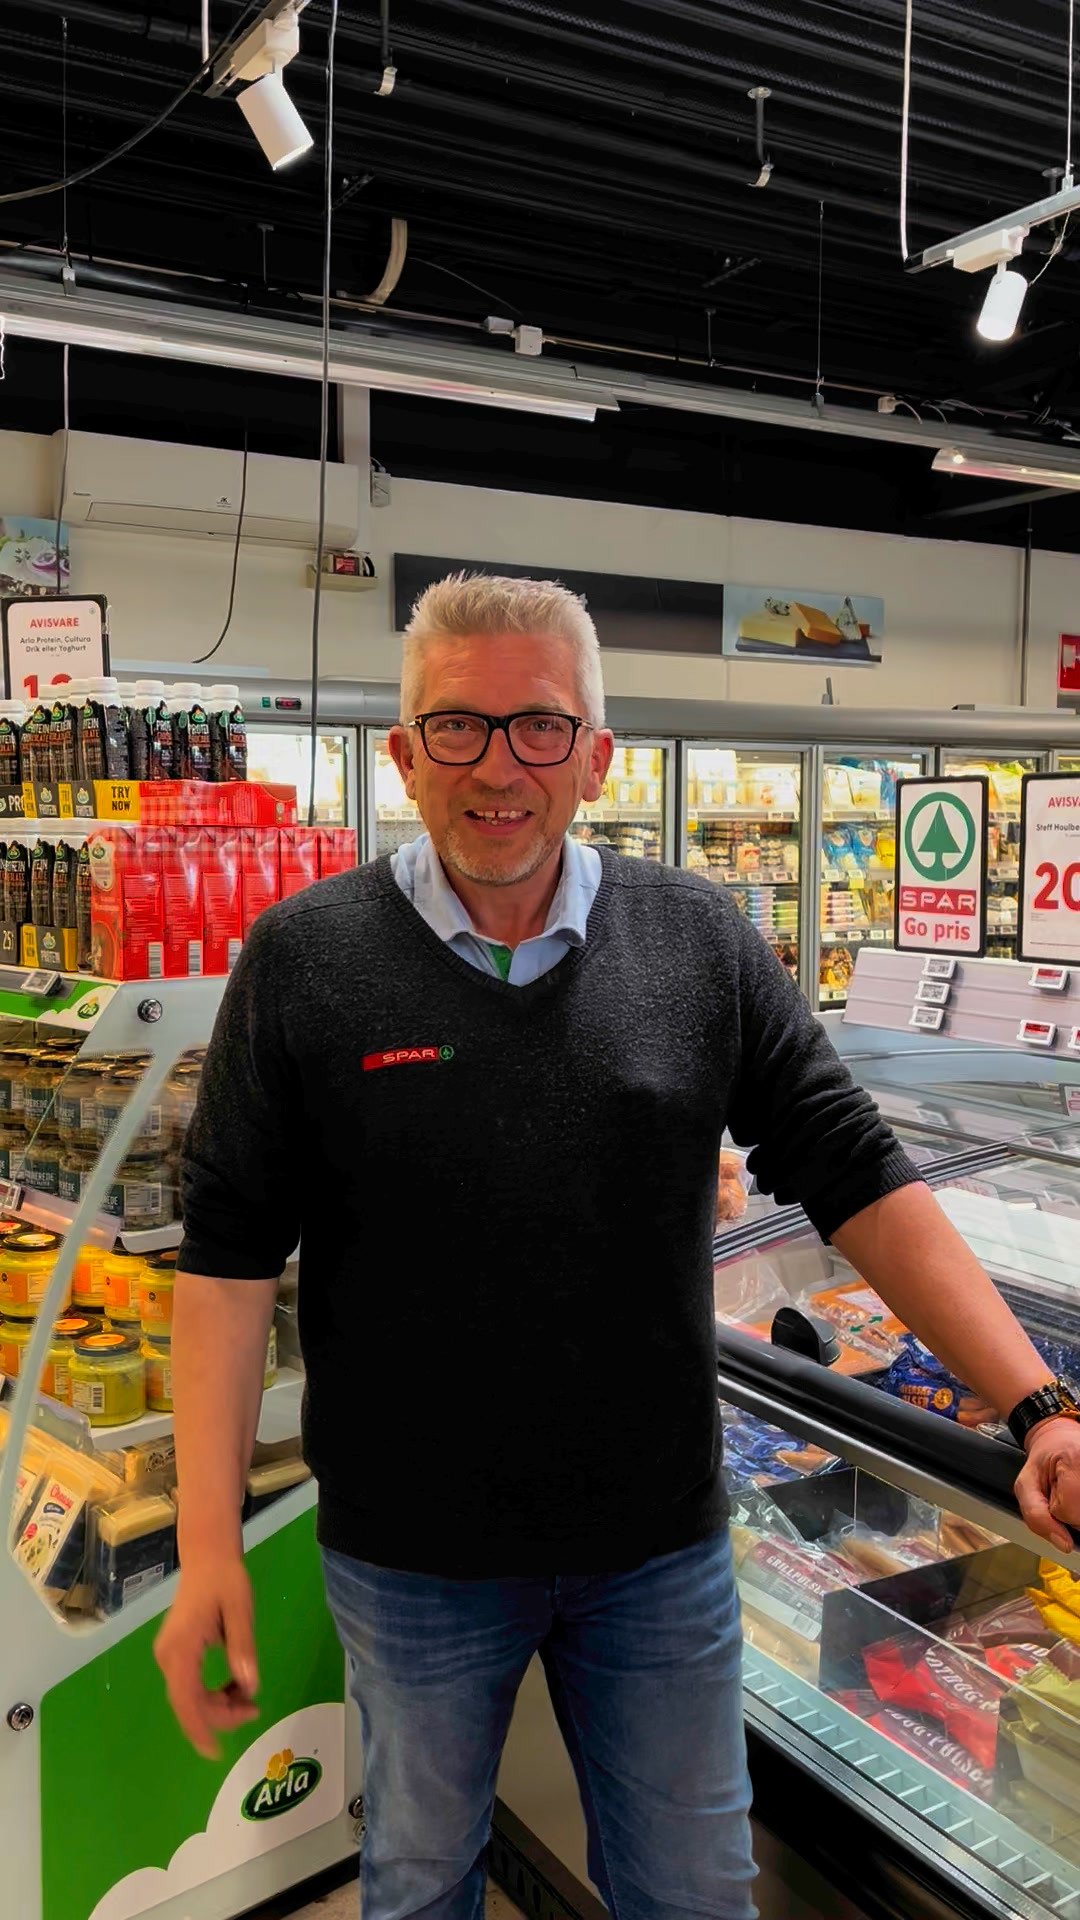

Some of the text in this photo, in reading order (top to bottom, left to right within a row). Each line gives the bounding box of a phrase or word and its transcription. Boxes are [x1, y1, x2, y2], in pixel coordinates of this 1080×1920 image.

[30, 617, 79, 629] AVISVARE
[111, 786, 130, 798] TRY
[111, 801, 131, 811] NOW
[1048, 796, 1080, 808] AVISV
[1036, 823, 1053, 832] Steff
[902, 890, 975, 911] SPAR
[904, 917, 970, 943] Go pris
[382, 1048, 436, 1064] SPAR
[253, 1769, 310, 1813] Arla
